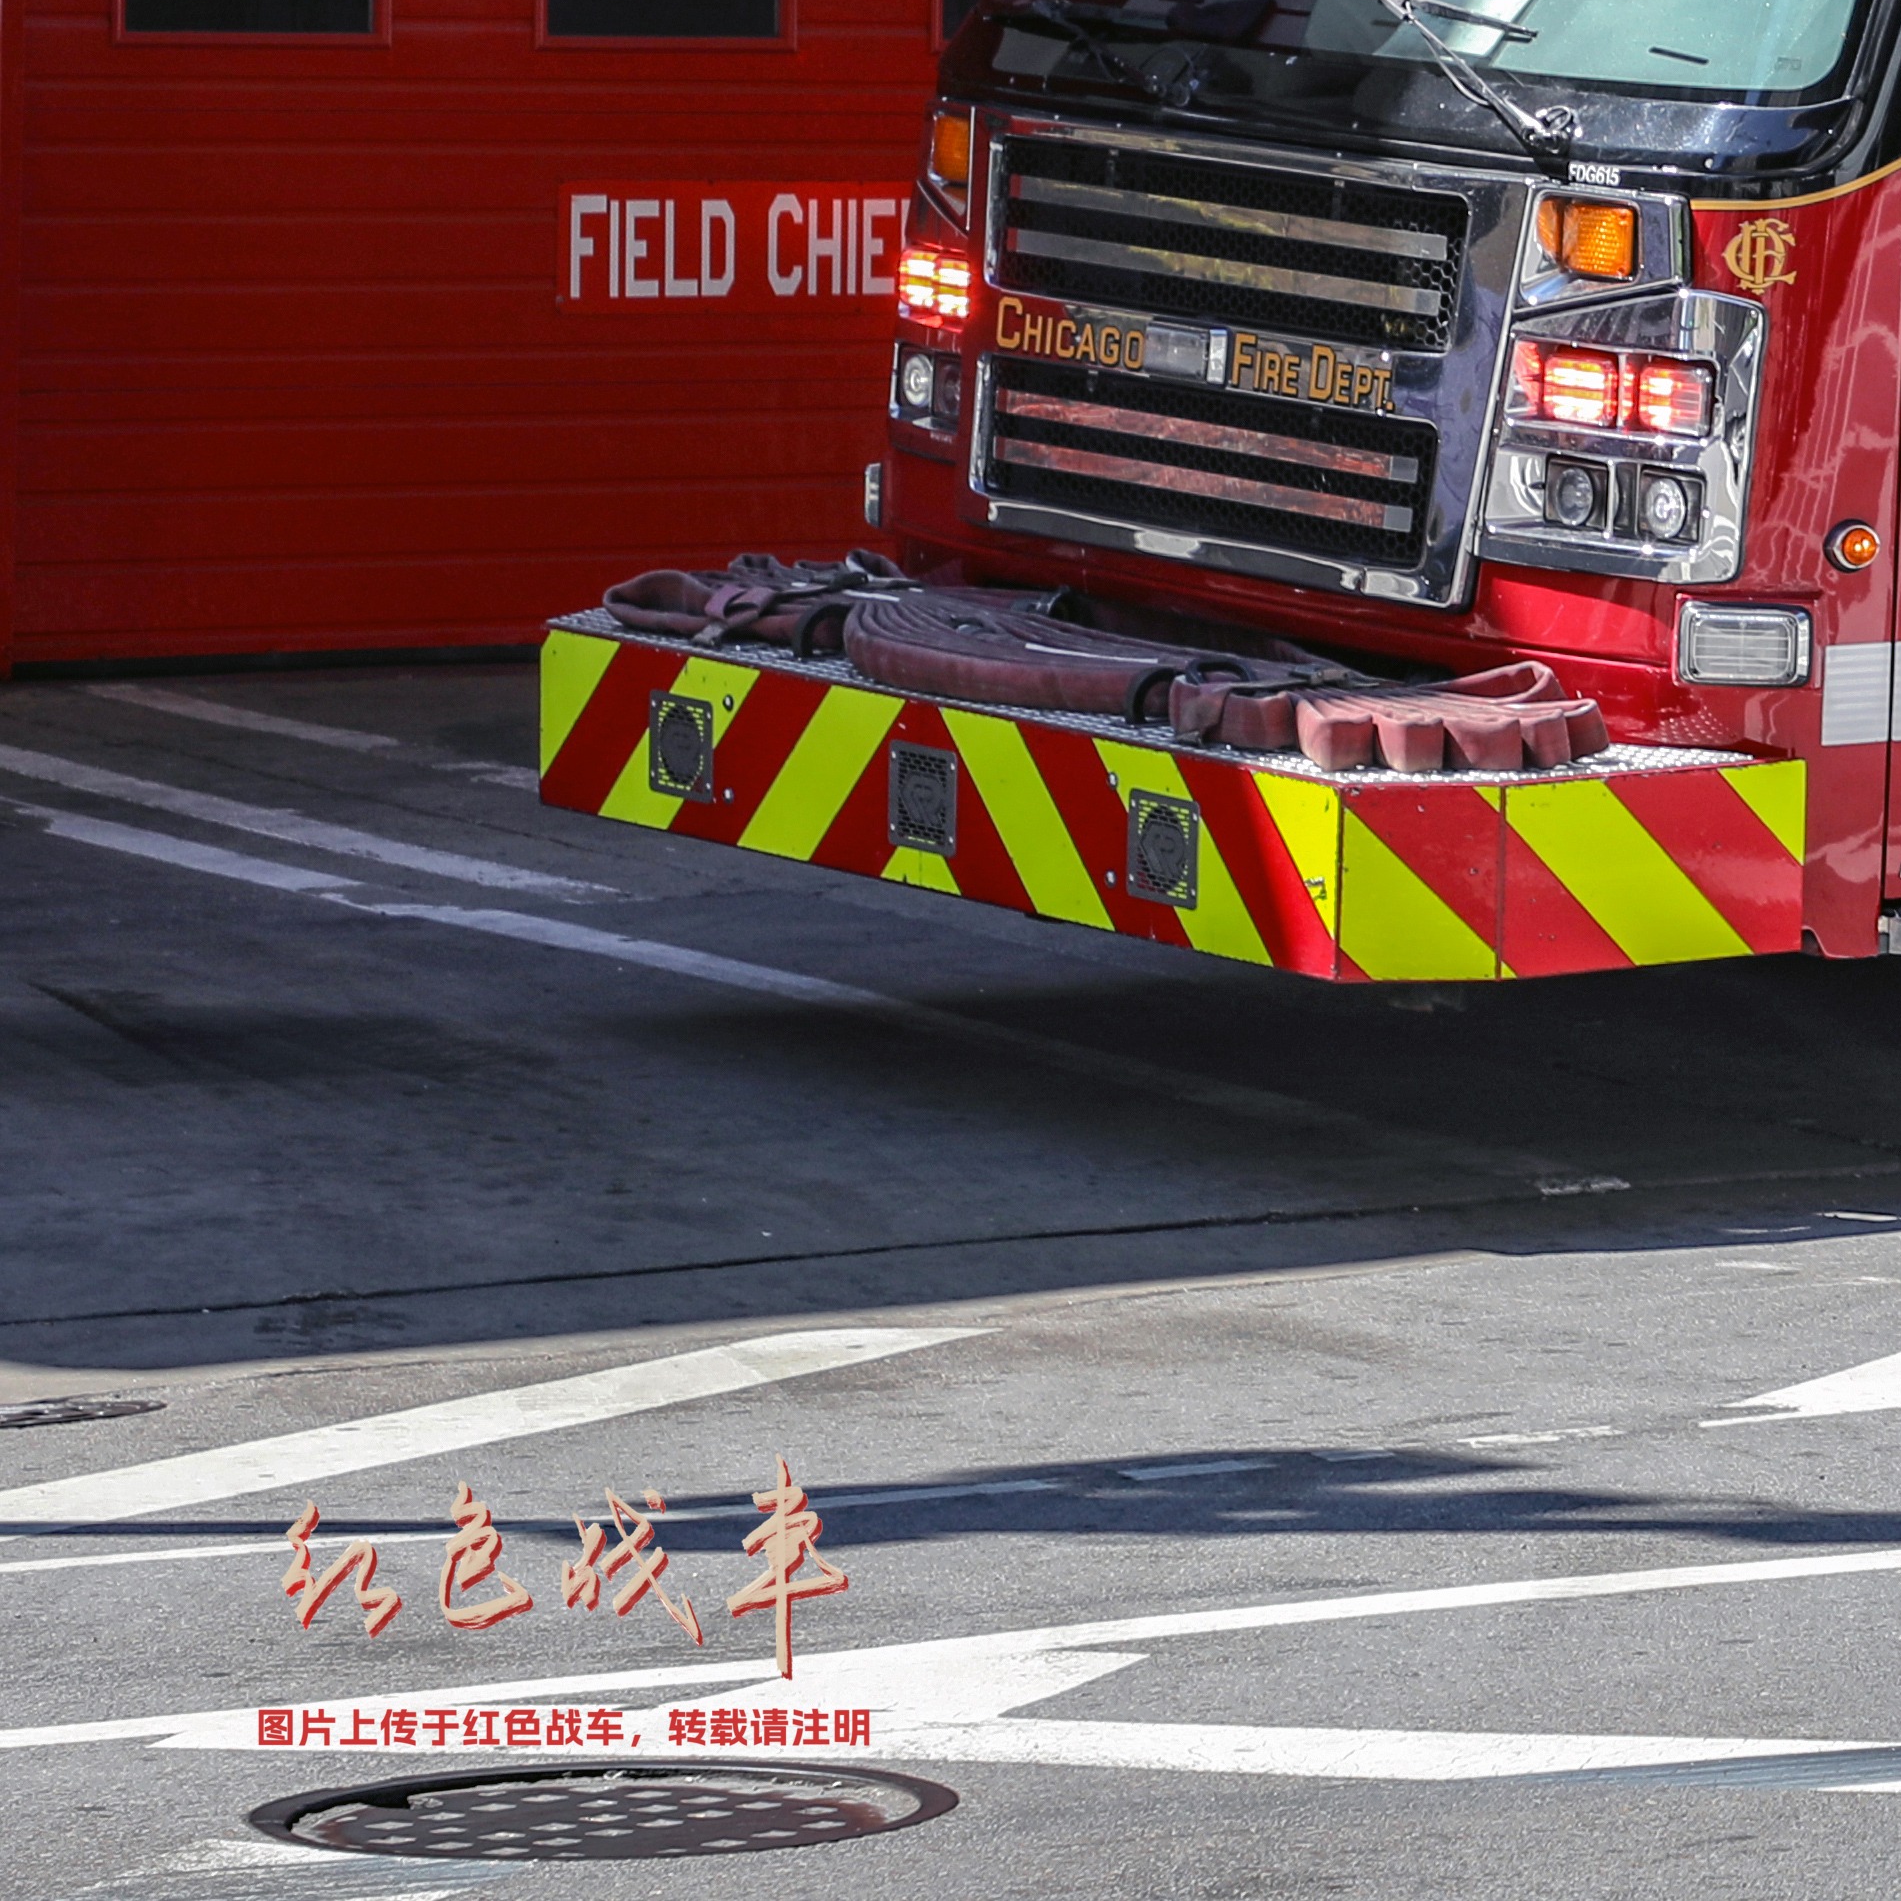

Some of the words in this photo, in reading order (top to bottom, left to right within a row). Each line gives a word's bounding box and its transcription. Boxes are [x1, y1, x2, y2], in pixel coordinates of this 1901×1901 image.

[1568, 161, 1621, 187] FDG615
[569, 194, 736, 299] FIELD
[996, 296, 1146, 370] CHICAGO
[1230, 332, 1301, 395] FIRE
[1308, 344, 1396, 411] DEPT.
